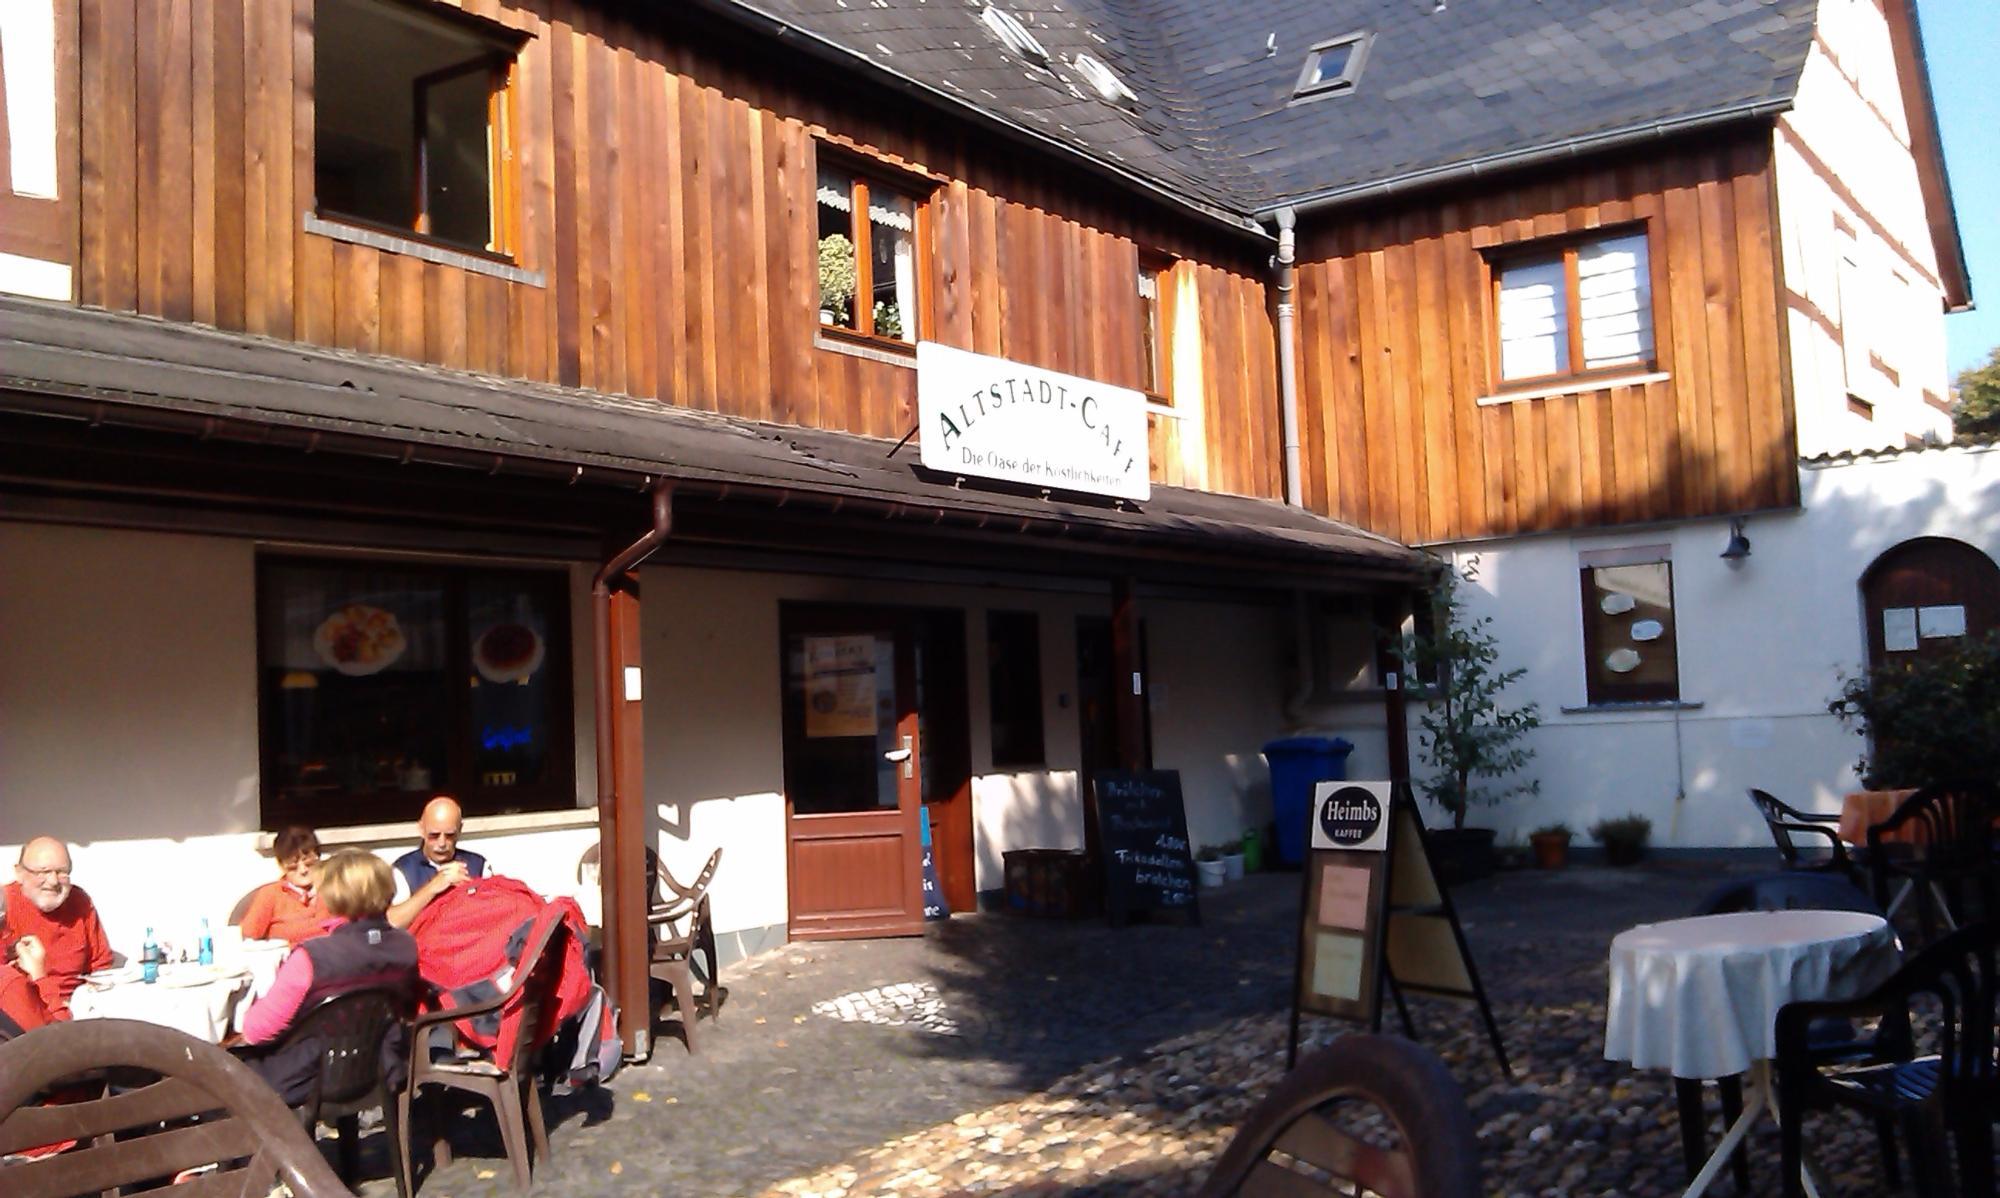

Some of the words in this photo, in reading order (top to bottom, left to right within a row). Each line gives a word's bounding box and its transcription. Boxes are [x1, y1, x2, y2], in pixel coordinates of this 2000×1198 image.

[962, 446, 983, 465] Die
[987, 450, 1017, 471] Oase
[1022, 457, 1041, 474] der
[1327, 799, 1378, 821] Heimbs
[1334, 828, 1362, 839] KAFFEE
